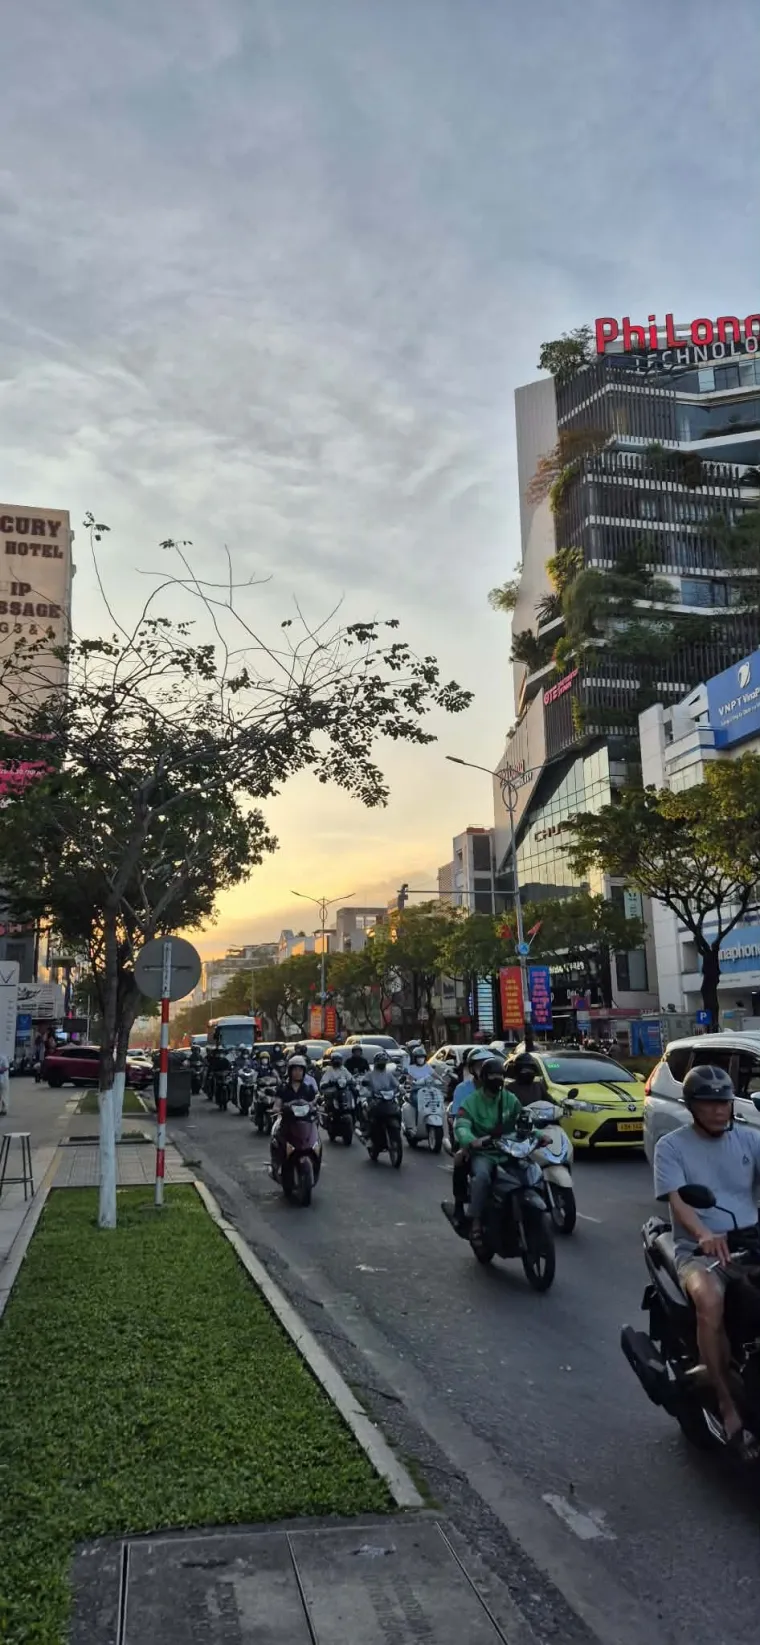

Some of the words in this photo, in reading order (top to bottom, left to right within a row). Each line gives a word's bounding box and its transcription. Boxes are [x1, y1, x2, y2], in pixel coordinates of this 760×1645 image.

[0, 515, 61, 537] CURY
[5, 541, 63, 559] HOTEL
[13, 623, 22, 634] 3
[29, 624, 38, 635] &
[718, 696, 742, 716] VNPT
[700, 1012, 707, 1020] P
